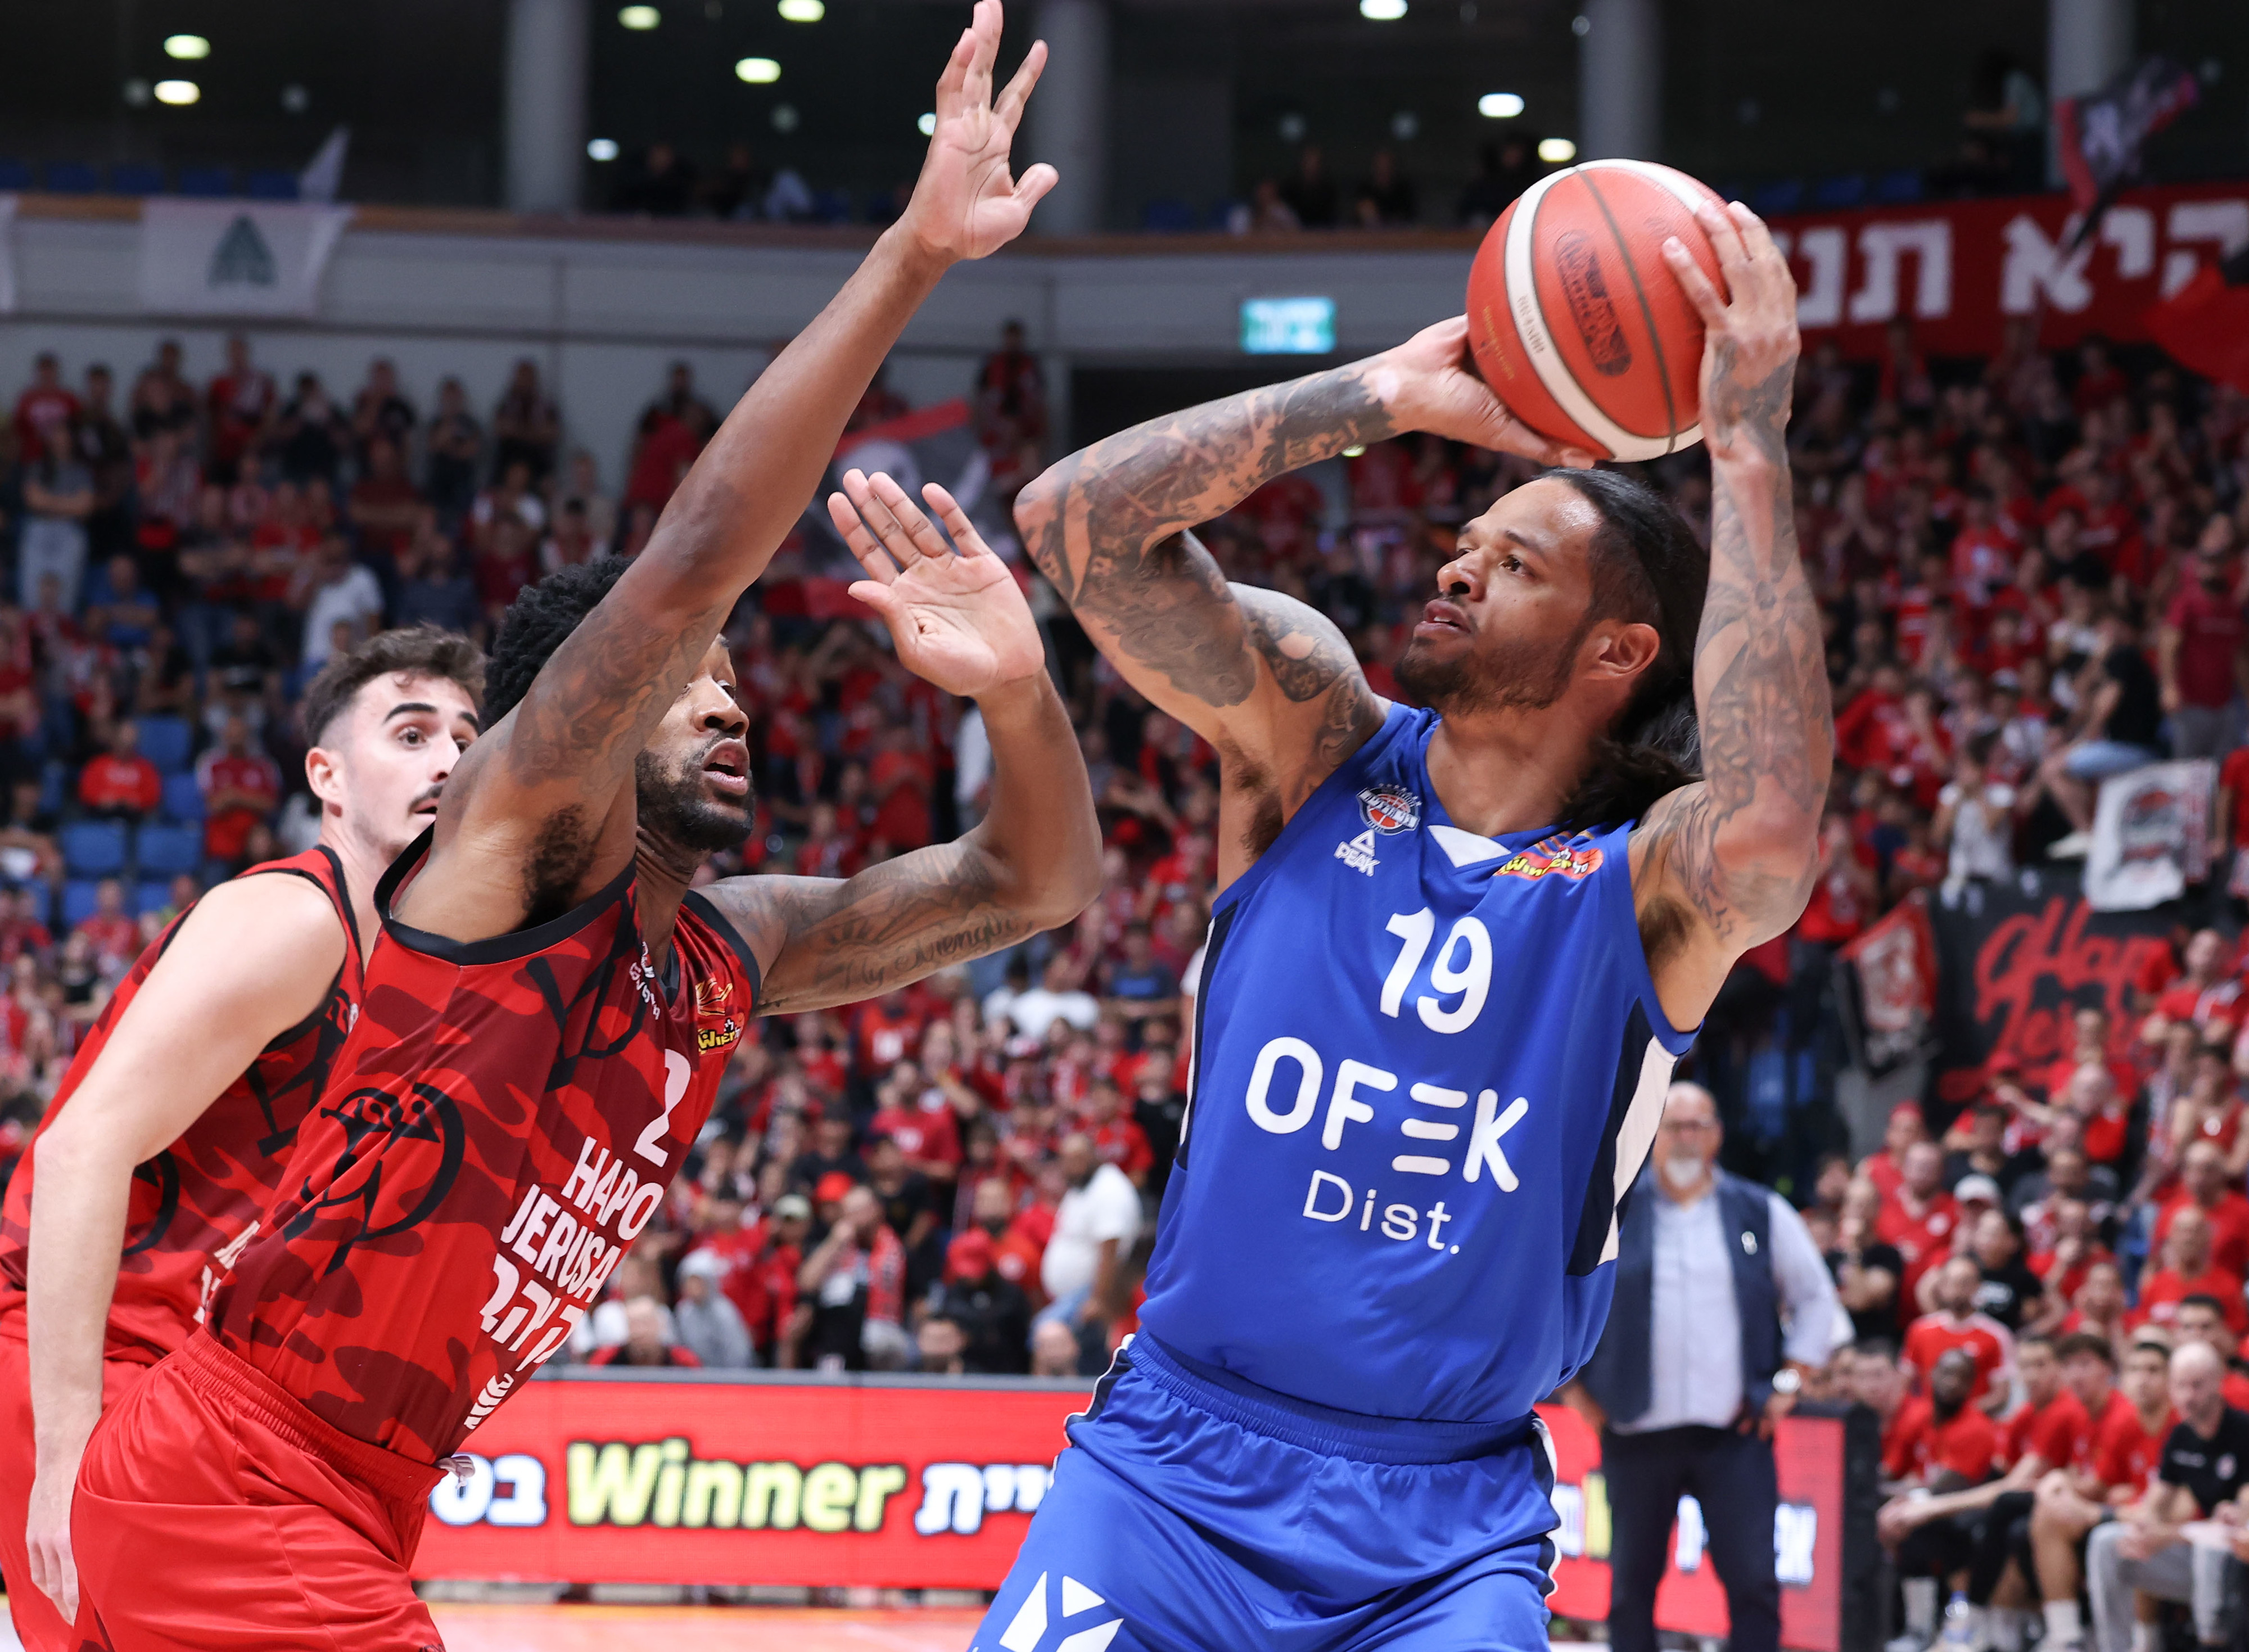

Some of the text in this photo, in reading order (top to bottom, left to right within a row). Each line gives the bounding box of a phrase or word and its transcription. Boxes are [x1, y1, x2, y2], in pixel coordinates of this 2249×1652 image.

[1772, 218, 1953, 328] תנ
[1334, 841, 1381, 877] PEAK
[1380, 906, 1493, 1034] 19
[633, 1048, 692, 1168] 2
[1245, 1037, 1529, 1193] OFEK
[1302, 1169, 1460, 1255] Dist.
[568, 1437, 906, 1533] Winner
